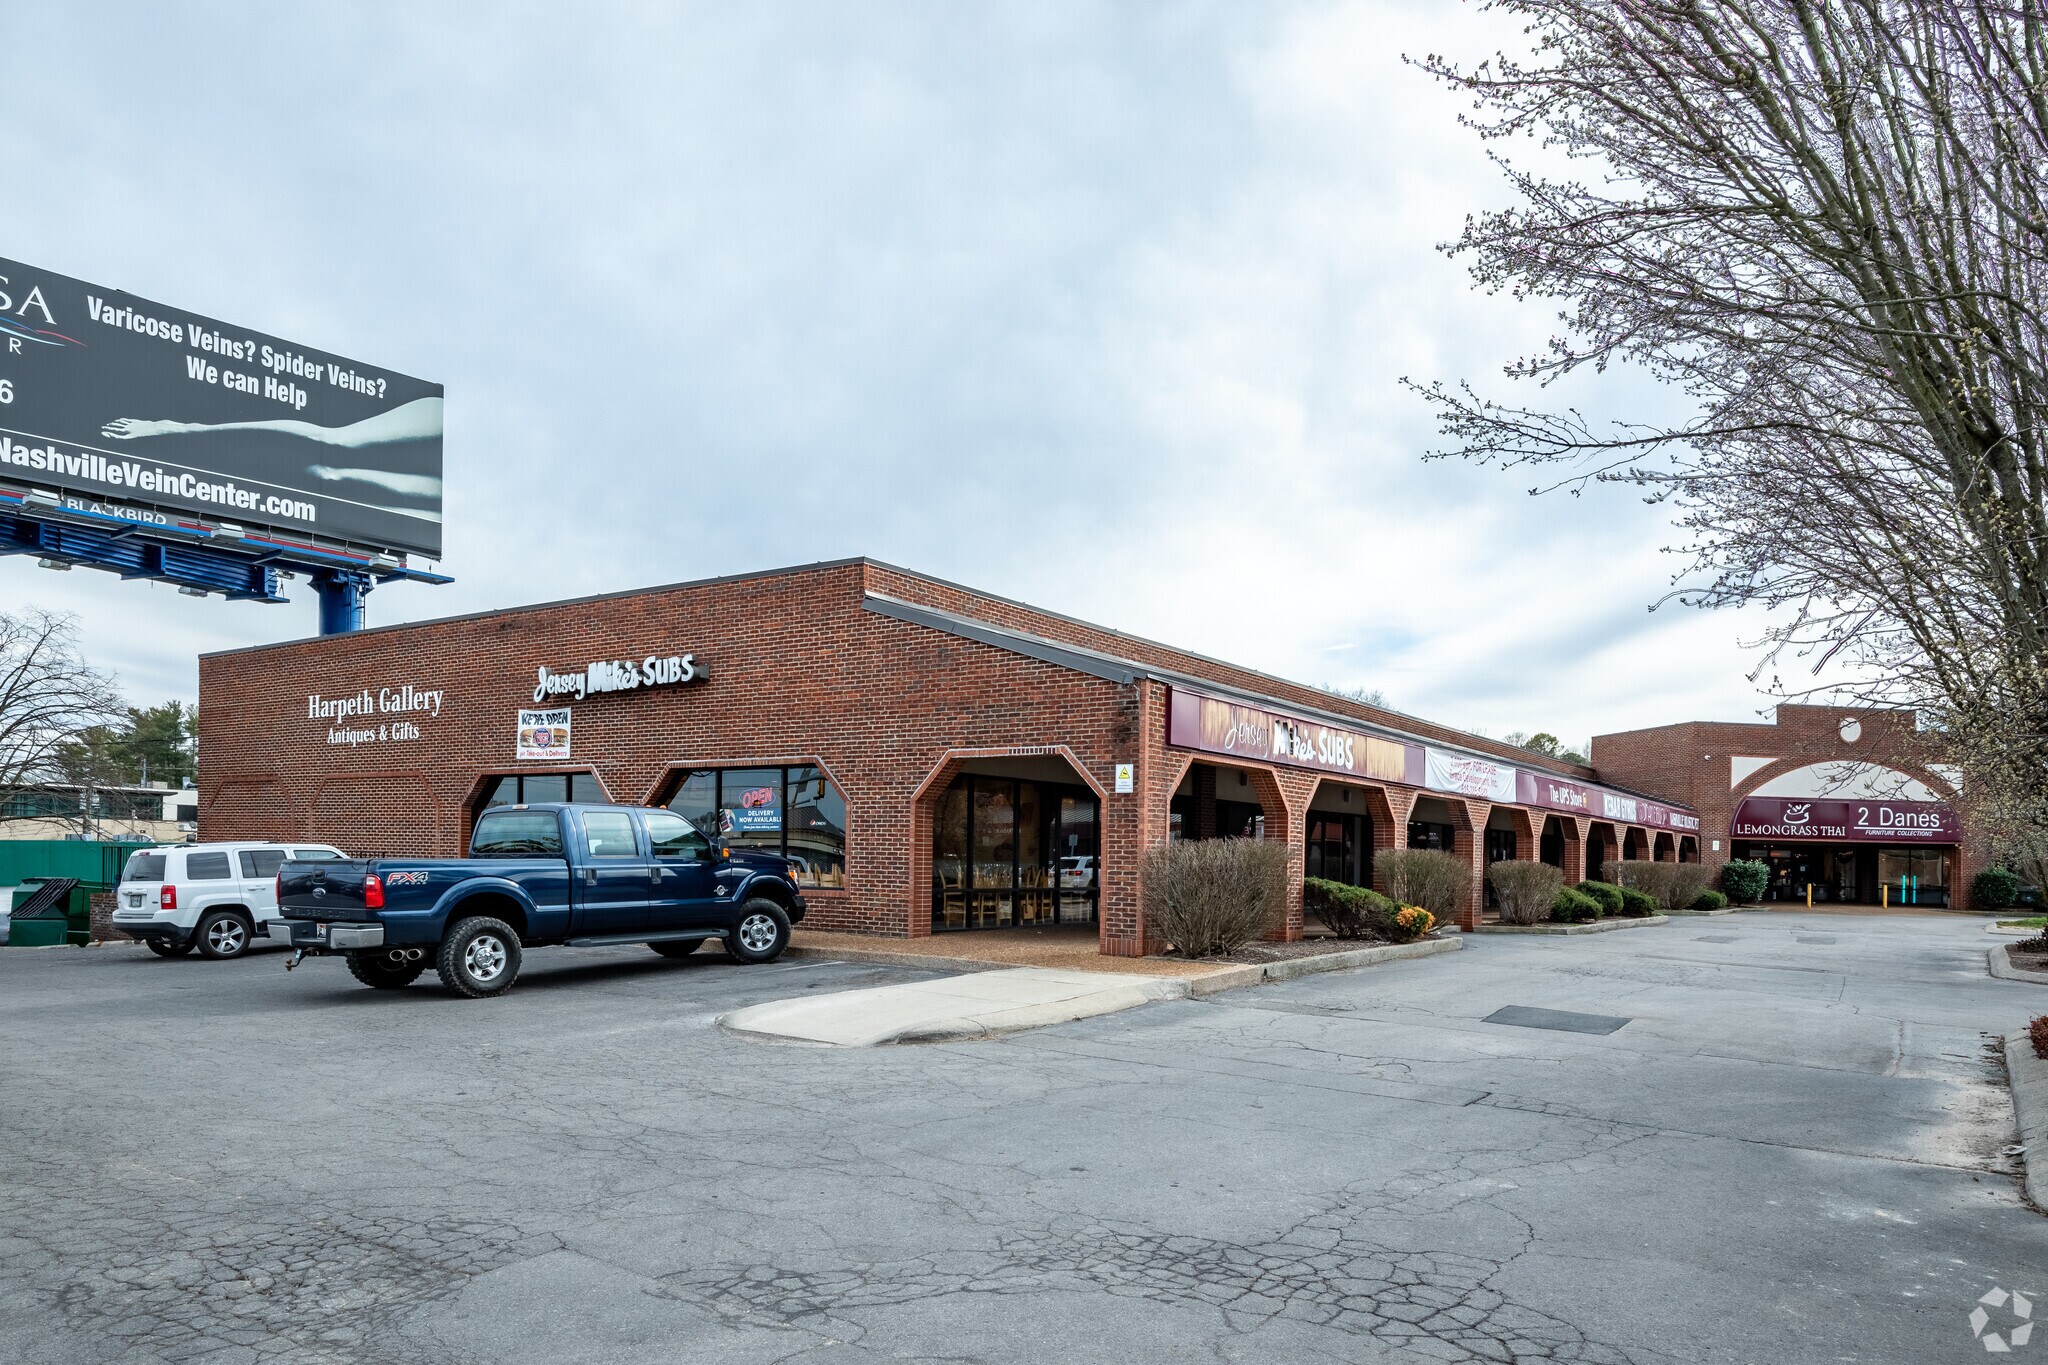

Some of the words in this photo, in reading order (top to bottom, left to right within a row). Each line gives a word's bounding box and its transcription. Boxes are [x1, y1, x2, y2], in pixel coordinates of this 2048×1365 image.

[87, 295, 183, 343] Varicose
[188, 323, 256, 362] Veins?
[261, 345, 324, 381] Spider
[327, 363, 387, 399] Veins?
[186, 355, 218, 384] We
[222, 370, 259, 395] can
[264, 376, 307, 410] Help
[66, 499, 167, 526] BLACKBIRD
[534, 666, 586, 702] Jersey
[587, 660, 643, 694] Mike's
[642, 654, 695, 686] SUBS
[308, 689, 374, 724] Harpeth
[379, 685, 444, 717] Gallery
[521, 713, 544, 725] WE'RE
[545, 711, 568, 725] OPEN
[327, 727, 375, 747] Antiques
[379, 725, 388, 741] &
[392, 722, 420, 740] Gifts
[1225, 706, 1269, 758] Jersey
[1273, 720, 1316, 760] Mike's
[1318, 727, 1354, 770] SUBS
[743, 787, 773, 808] OPEN
[1549, 784, 1559, 803] The
[1559, 787, 1569, 805] UPS
[1570, 789, 1583, 807] Store
[747, 809, 774, 817] DELIVERY
[1858, 807, 1869, 826] 2
[1880, 807, 1940, 827] Danes
[1737, 824, 1819, 836] LEMONGRASS
[1822, 826, 1846, 836] THAI
[387, 872, 428, 883] FX4
